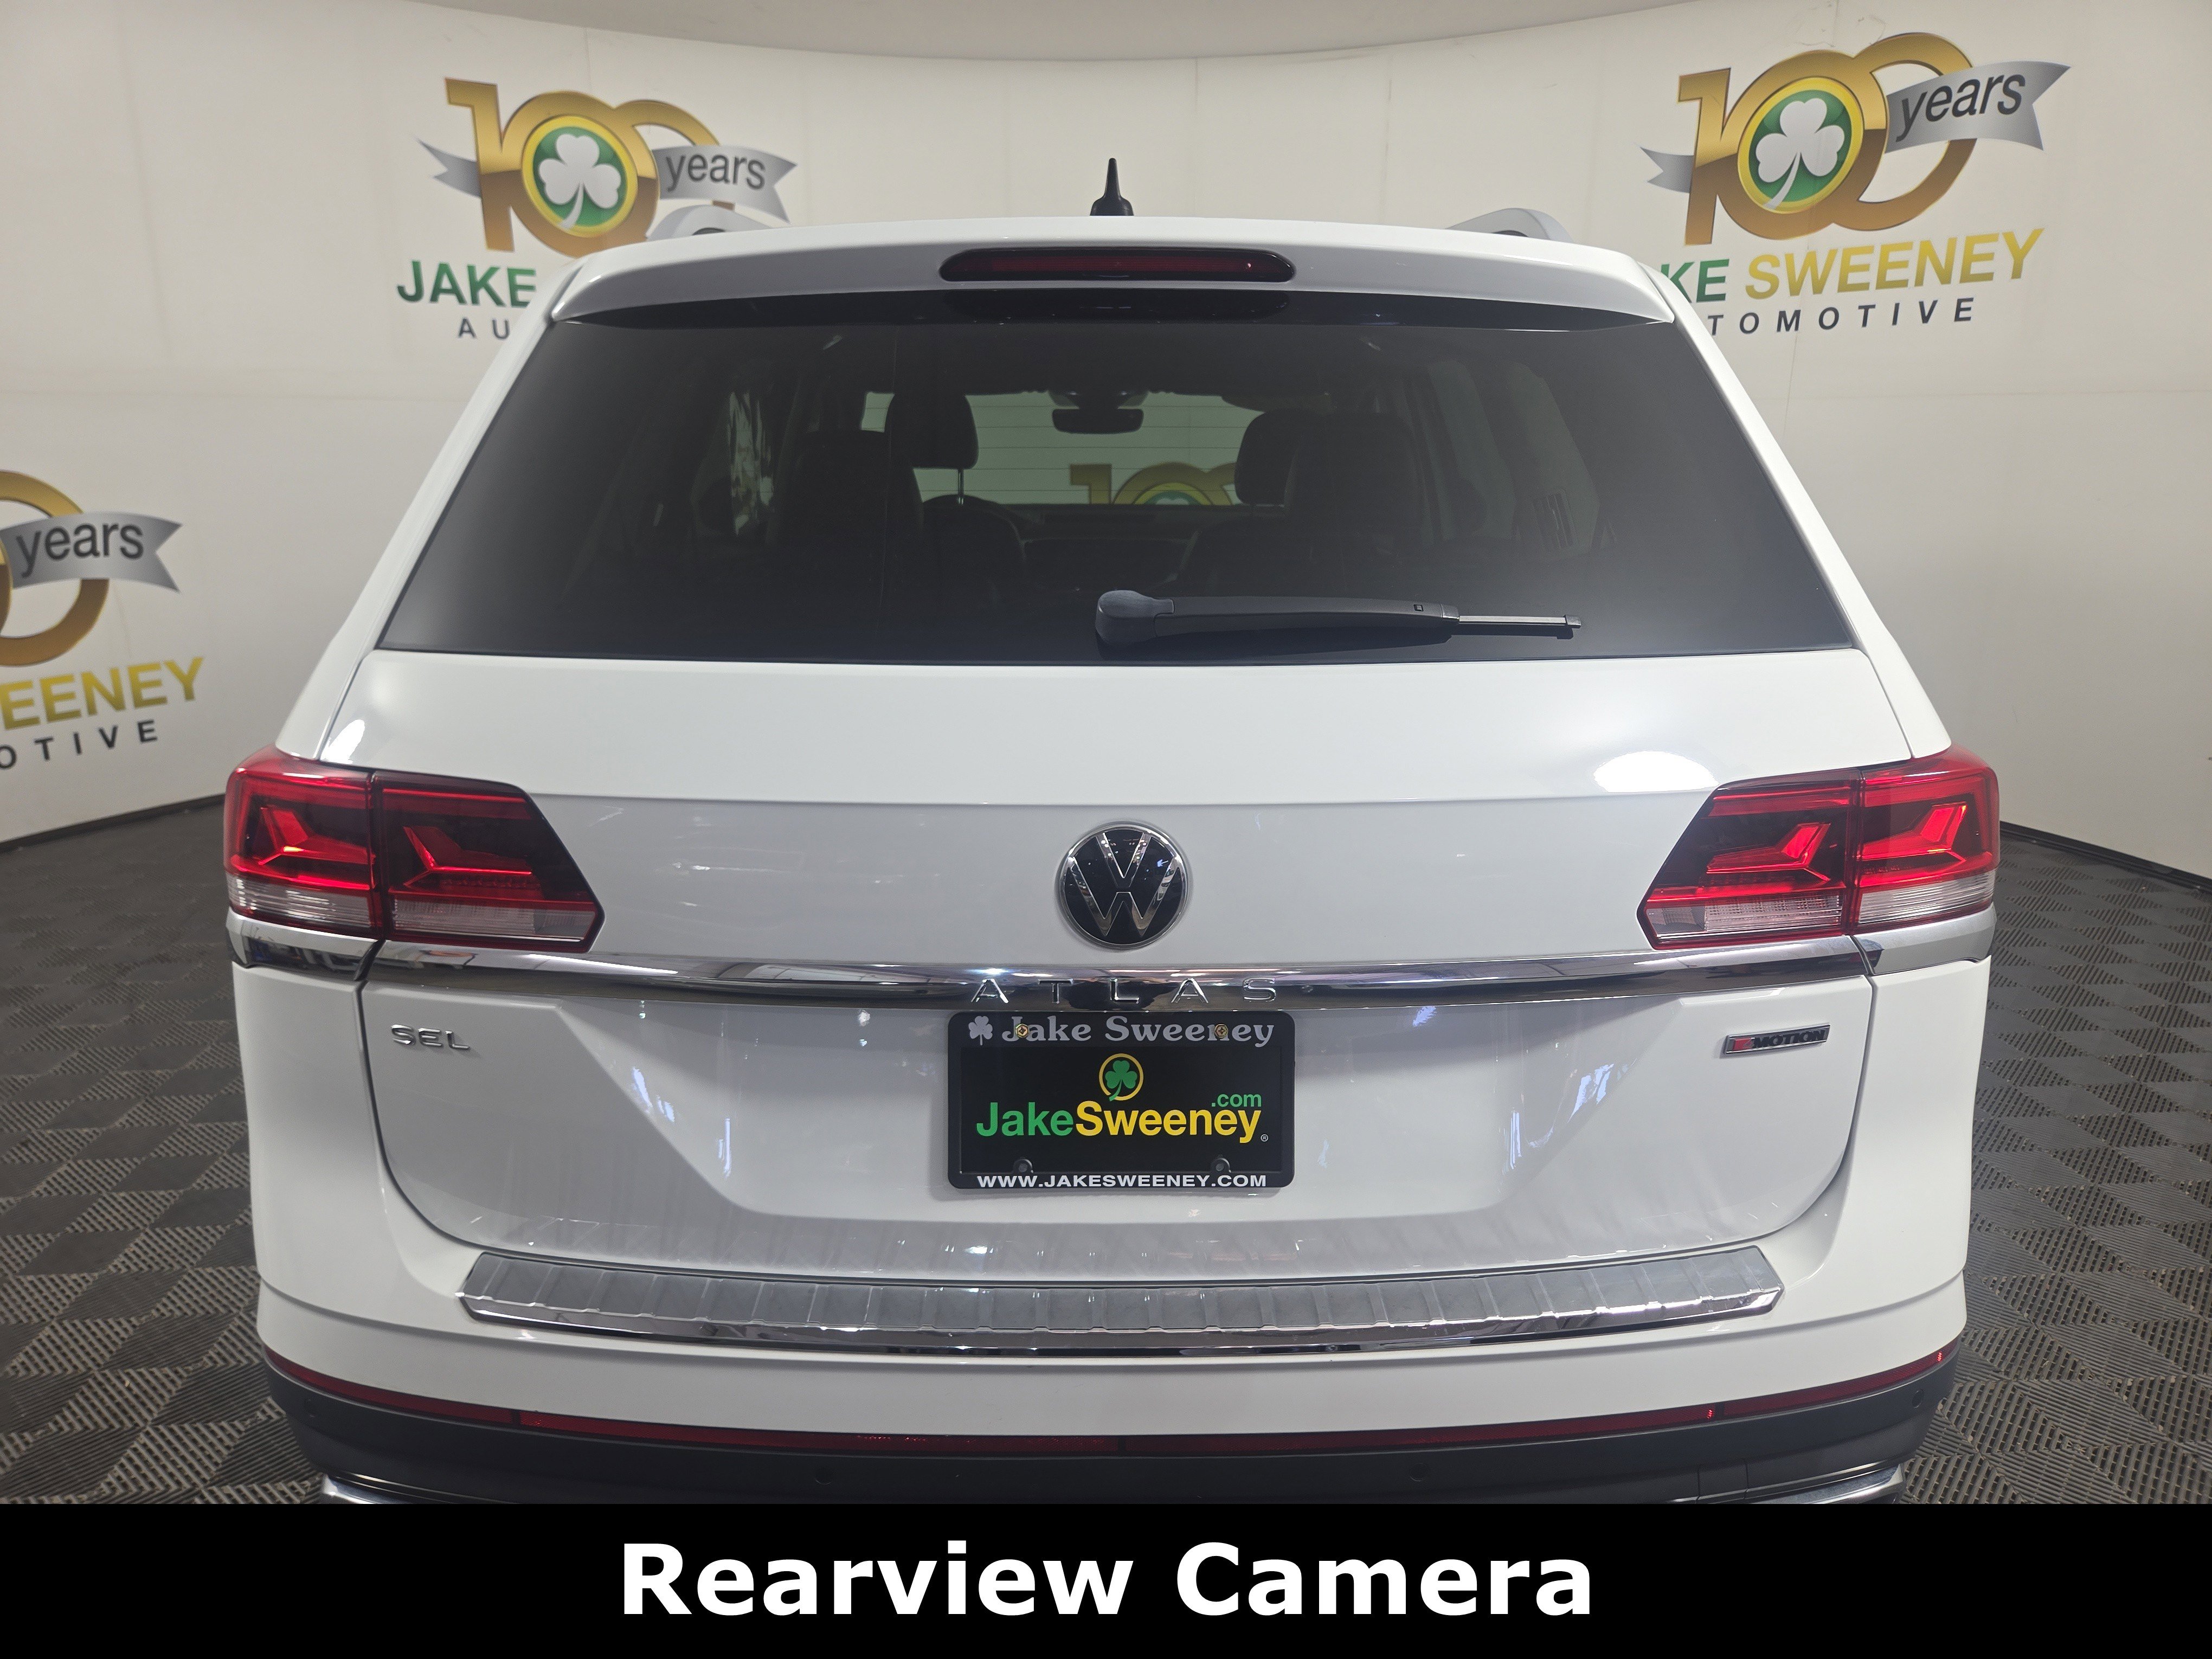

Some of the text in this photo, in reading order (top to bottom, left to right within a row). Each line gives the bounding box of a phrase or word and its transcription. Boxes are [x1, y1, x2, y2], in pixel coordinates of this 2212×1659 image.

[1896, 74, 2025, 142] years
[666, 149, 766, 191] years
[397, 260, 536, 308] JAKE
[1661, 228, 2044, 303] KE SWEENEY
[1708, 298, 1974, 335] TOMOTIVE
[16, 522, 144, 578] years
[0, 657, 203, 730] EENEY
[0, 719, 158, 770] OTIVE
[971, 978, 1277, 1004] ATLAS
[391, 1024, 470, 1049] SEL
[1002, 1015, 1275, 1047] Jake Sweeney
[1211, 1094, 1262, 1107] .com
[976, 1175, 1266, 1187] WWW.JAKESWEENEY.COM
